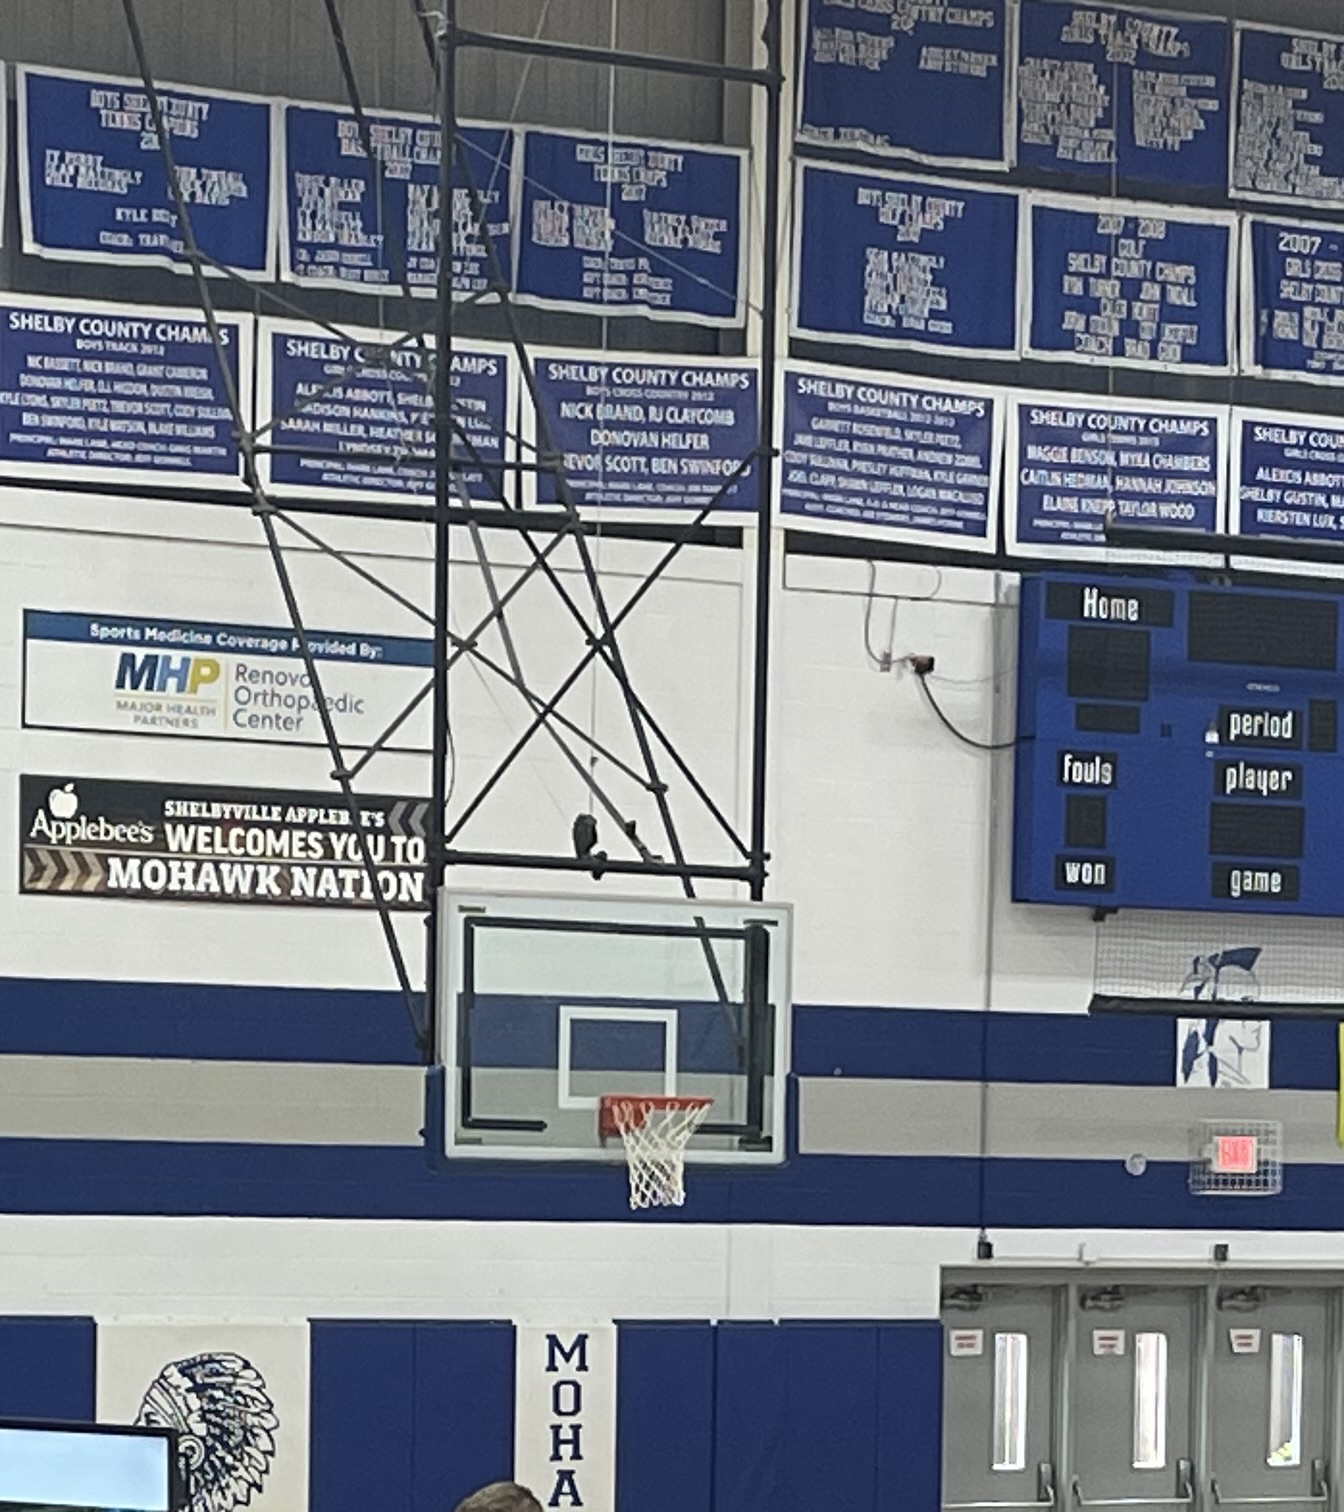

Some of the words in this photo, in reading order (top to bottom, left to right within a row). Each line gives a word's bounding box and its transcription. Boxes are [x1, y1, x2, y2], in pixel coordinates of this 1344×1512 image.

[1278, 232, 1321, 254] 2007
[9, 312, 76, 332] SHELBY
[79, 317, 152, 338] COUNTY
[156, 324, 230, 346] CHAMS
[286, 340, 350, 360] SHELBY
[548, 364, 609, 382] SHELBY
[612, 367, 679, 387] COUNTY
[682, 371, 750, 390] CHAMPS
[798, 378, 855, 399] SHELBY
[857, 386, 920, 410] COUNTY
[922, 396, 985, 418] CHAMPS
[1030, 409, 1085, 428] SHELBY
[1087, 413, 1147, 432] COUNTY
[1149, 418, 1210, 436] CHAMPS
[1254, 427, 1307, 445] SHELBY
[590, 428, 659, 449] DONOVAN
[1082, 586, 1140, 622] Home
[89, 622, 141, 641] Sports
[144, 626, 213, 646] Medicine
[216, 632, 288, 652] Coverage
[359, 641, 384, 660] By:
[115, 652, 221, 694] MHP
[116, 700, 163, 714] MAJOR
[166, 702, 216, 717] HEALTH
[133, 714, 199, 729] PARTNERS
[232, 708, 304, 732] Center
[1228, 707, 1294, 741] period
[1062, 753, 1113, 785] fouls
[1224, 762, 1294, 797] player
[28, 807, 155, 845] Applebee's
[164, 799, 283, 824] SHELBYVILLE
[285, 802, 385, 828] APPLEBE'S
[165, 823, 324, 860] WELCOMES
[328, 832, 385, 862] YOU
[390, 834, 426, 865] TO
[107, 857, 282, 897] MOHAWK
[289, 864, 425, 903] NATION
[1064, 861, 1107, 886] won
[1229, 868, 1283, 899] game
